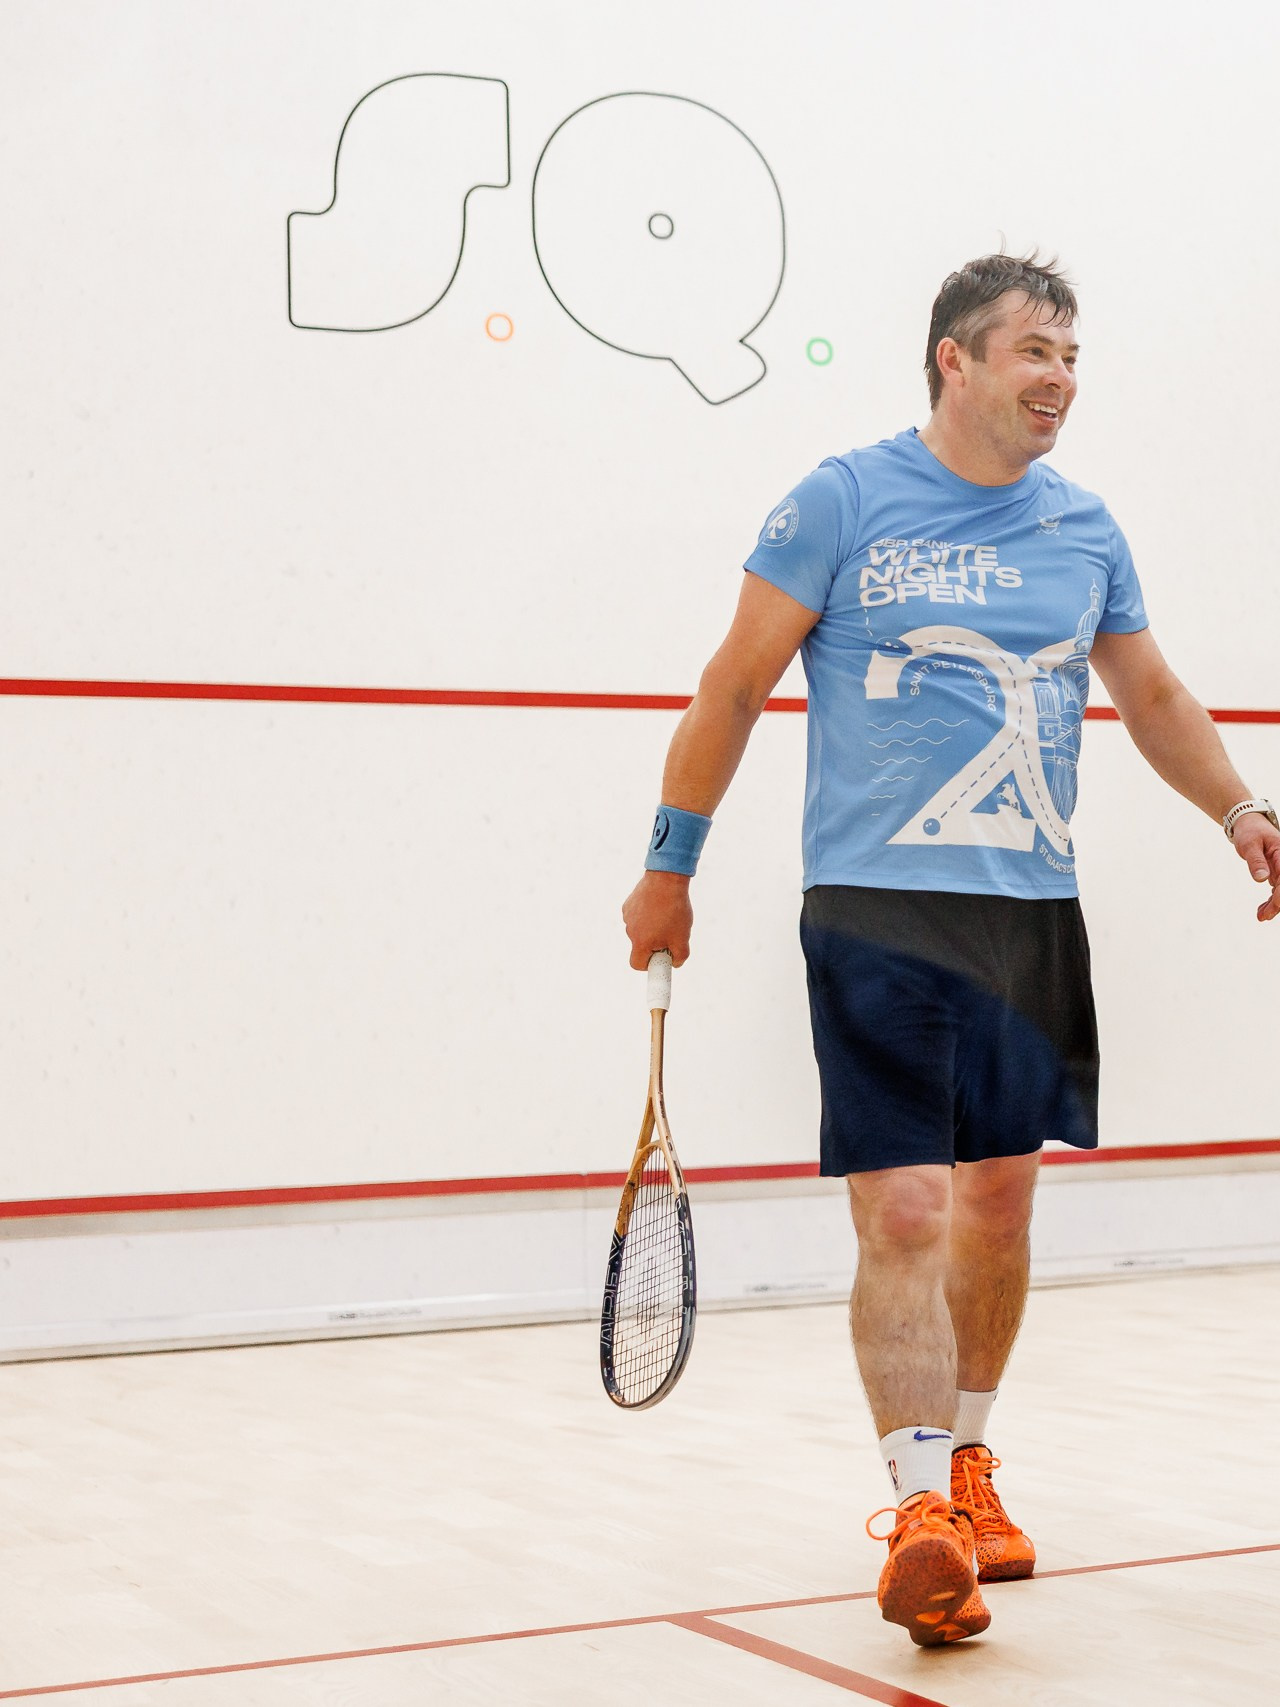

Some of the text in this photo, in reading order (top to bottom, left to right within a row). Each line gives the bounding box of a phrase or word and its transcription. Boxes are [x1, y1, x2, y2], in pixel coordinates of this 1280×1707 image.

[868, 544, 999, 567] WHITE
[911, 538, 954, 550] BANK
[859, 563, 1023, 589] NIGHTS
[859, 582, 987, 608] OPEN
[910, 660, 996, 712] SAINT PETERSBURG
